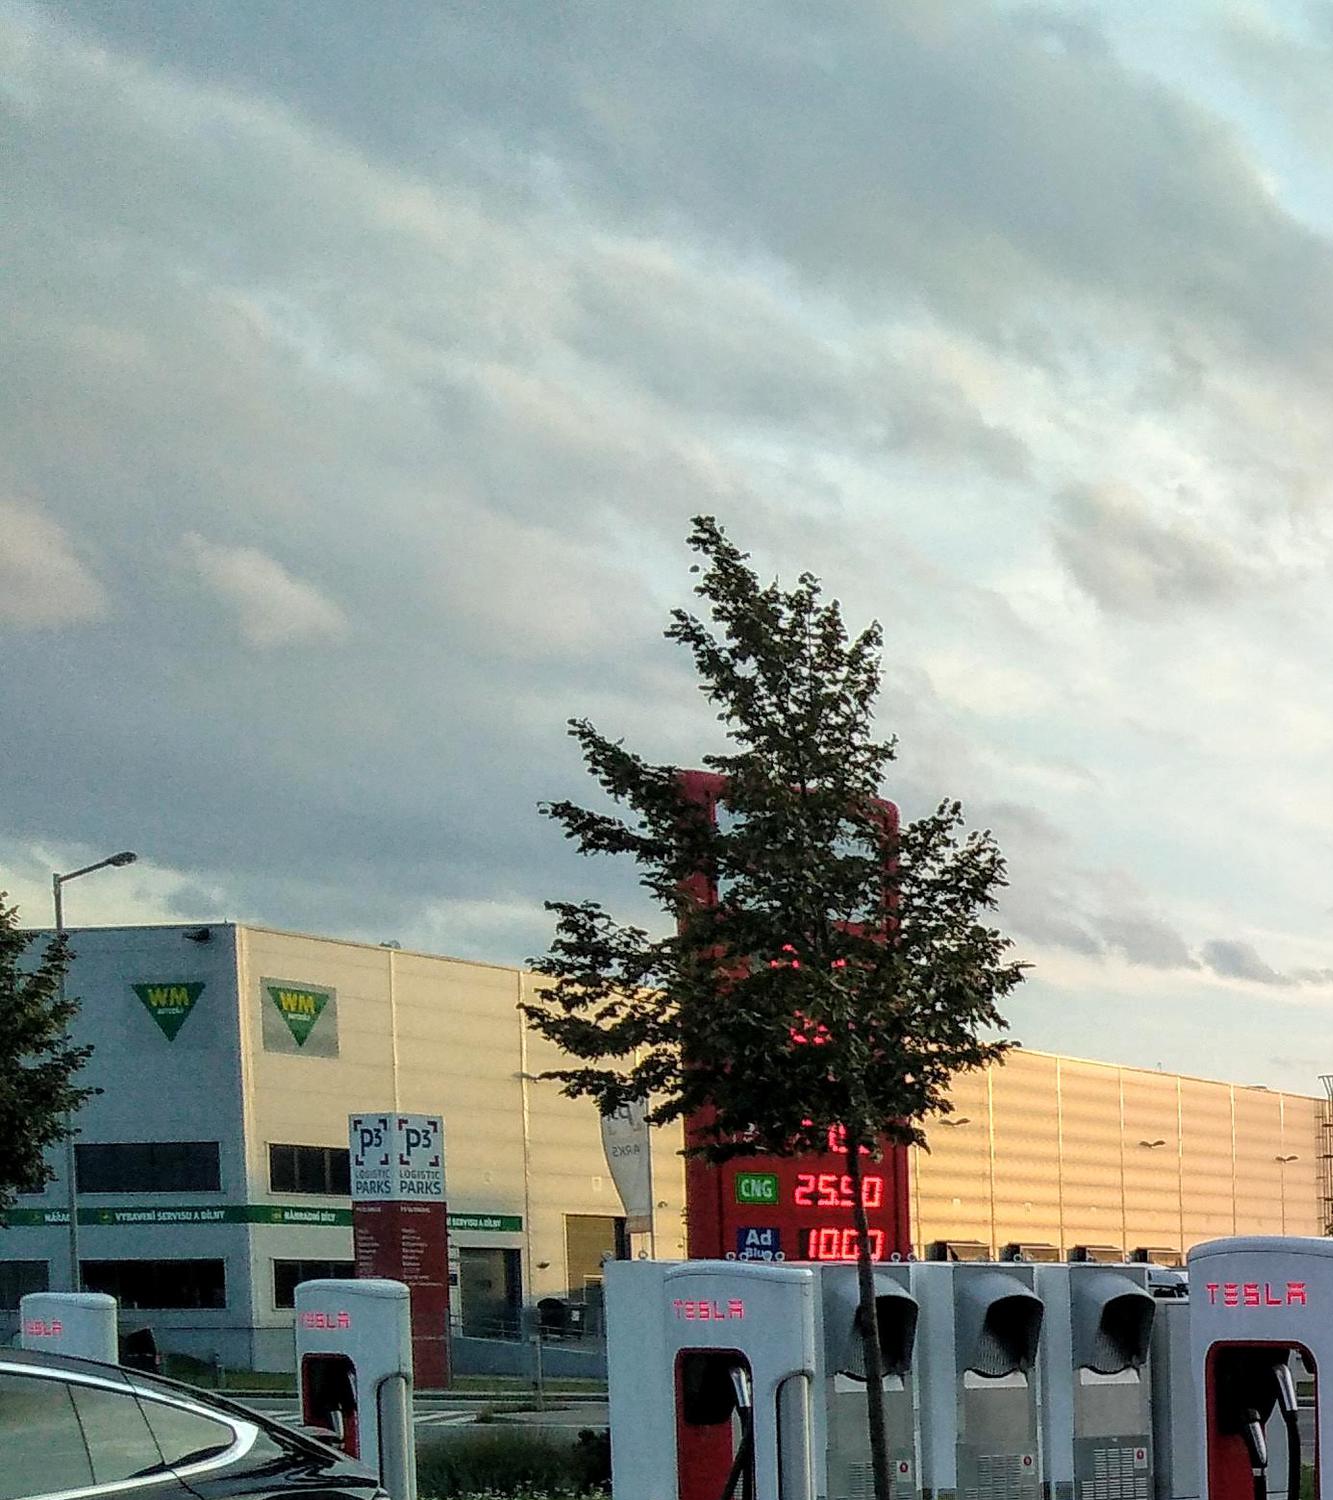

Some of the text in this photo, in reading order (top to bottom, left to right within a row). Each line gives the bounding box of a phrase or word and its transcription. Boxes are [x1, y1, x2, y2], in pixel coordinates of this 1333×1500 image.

[148, 987, 189, 1006] WM
[279, 991, 315, 1014] WM
[400, 1170, 440, 1180] LOGISTIC
[356, 1180, 391, 1194] PARKS
[400, 1181, 442, 1195] PARKS
[740, 1179, 772, 1198] CNG
[745, 1229, 772, 1245] Ad
[1206, 1282, 1307, 1307] TESLA
[673, 1299, 745, 1320] TESLA
